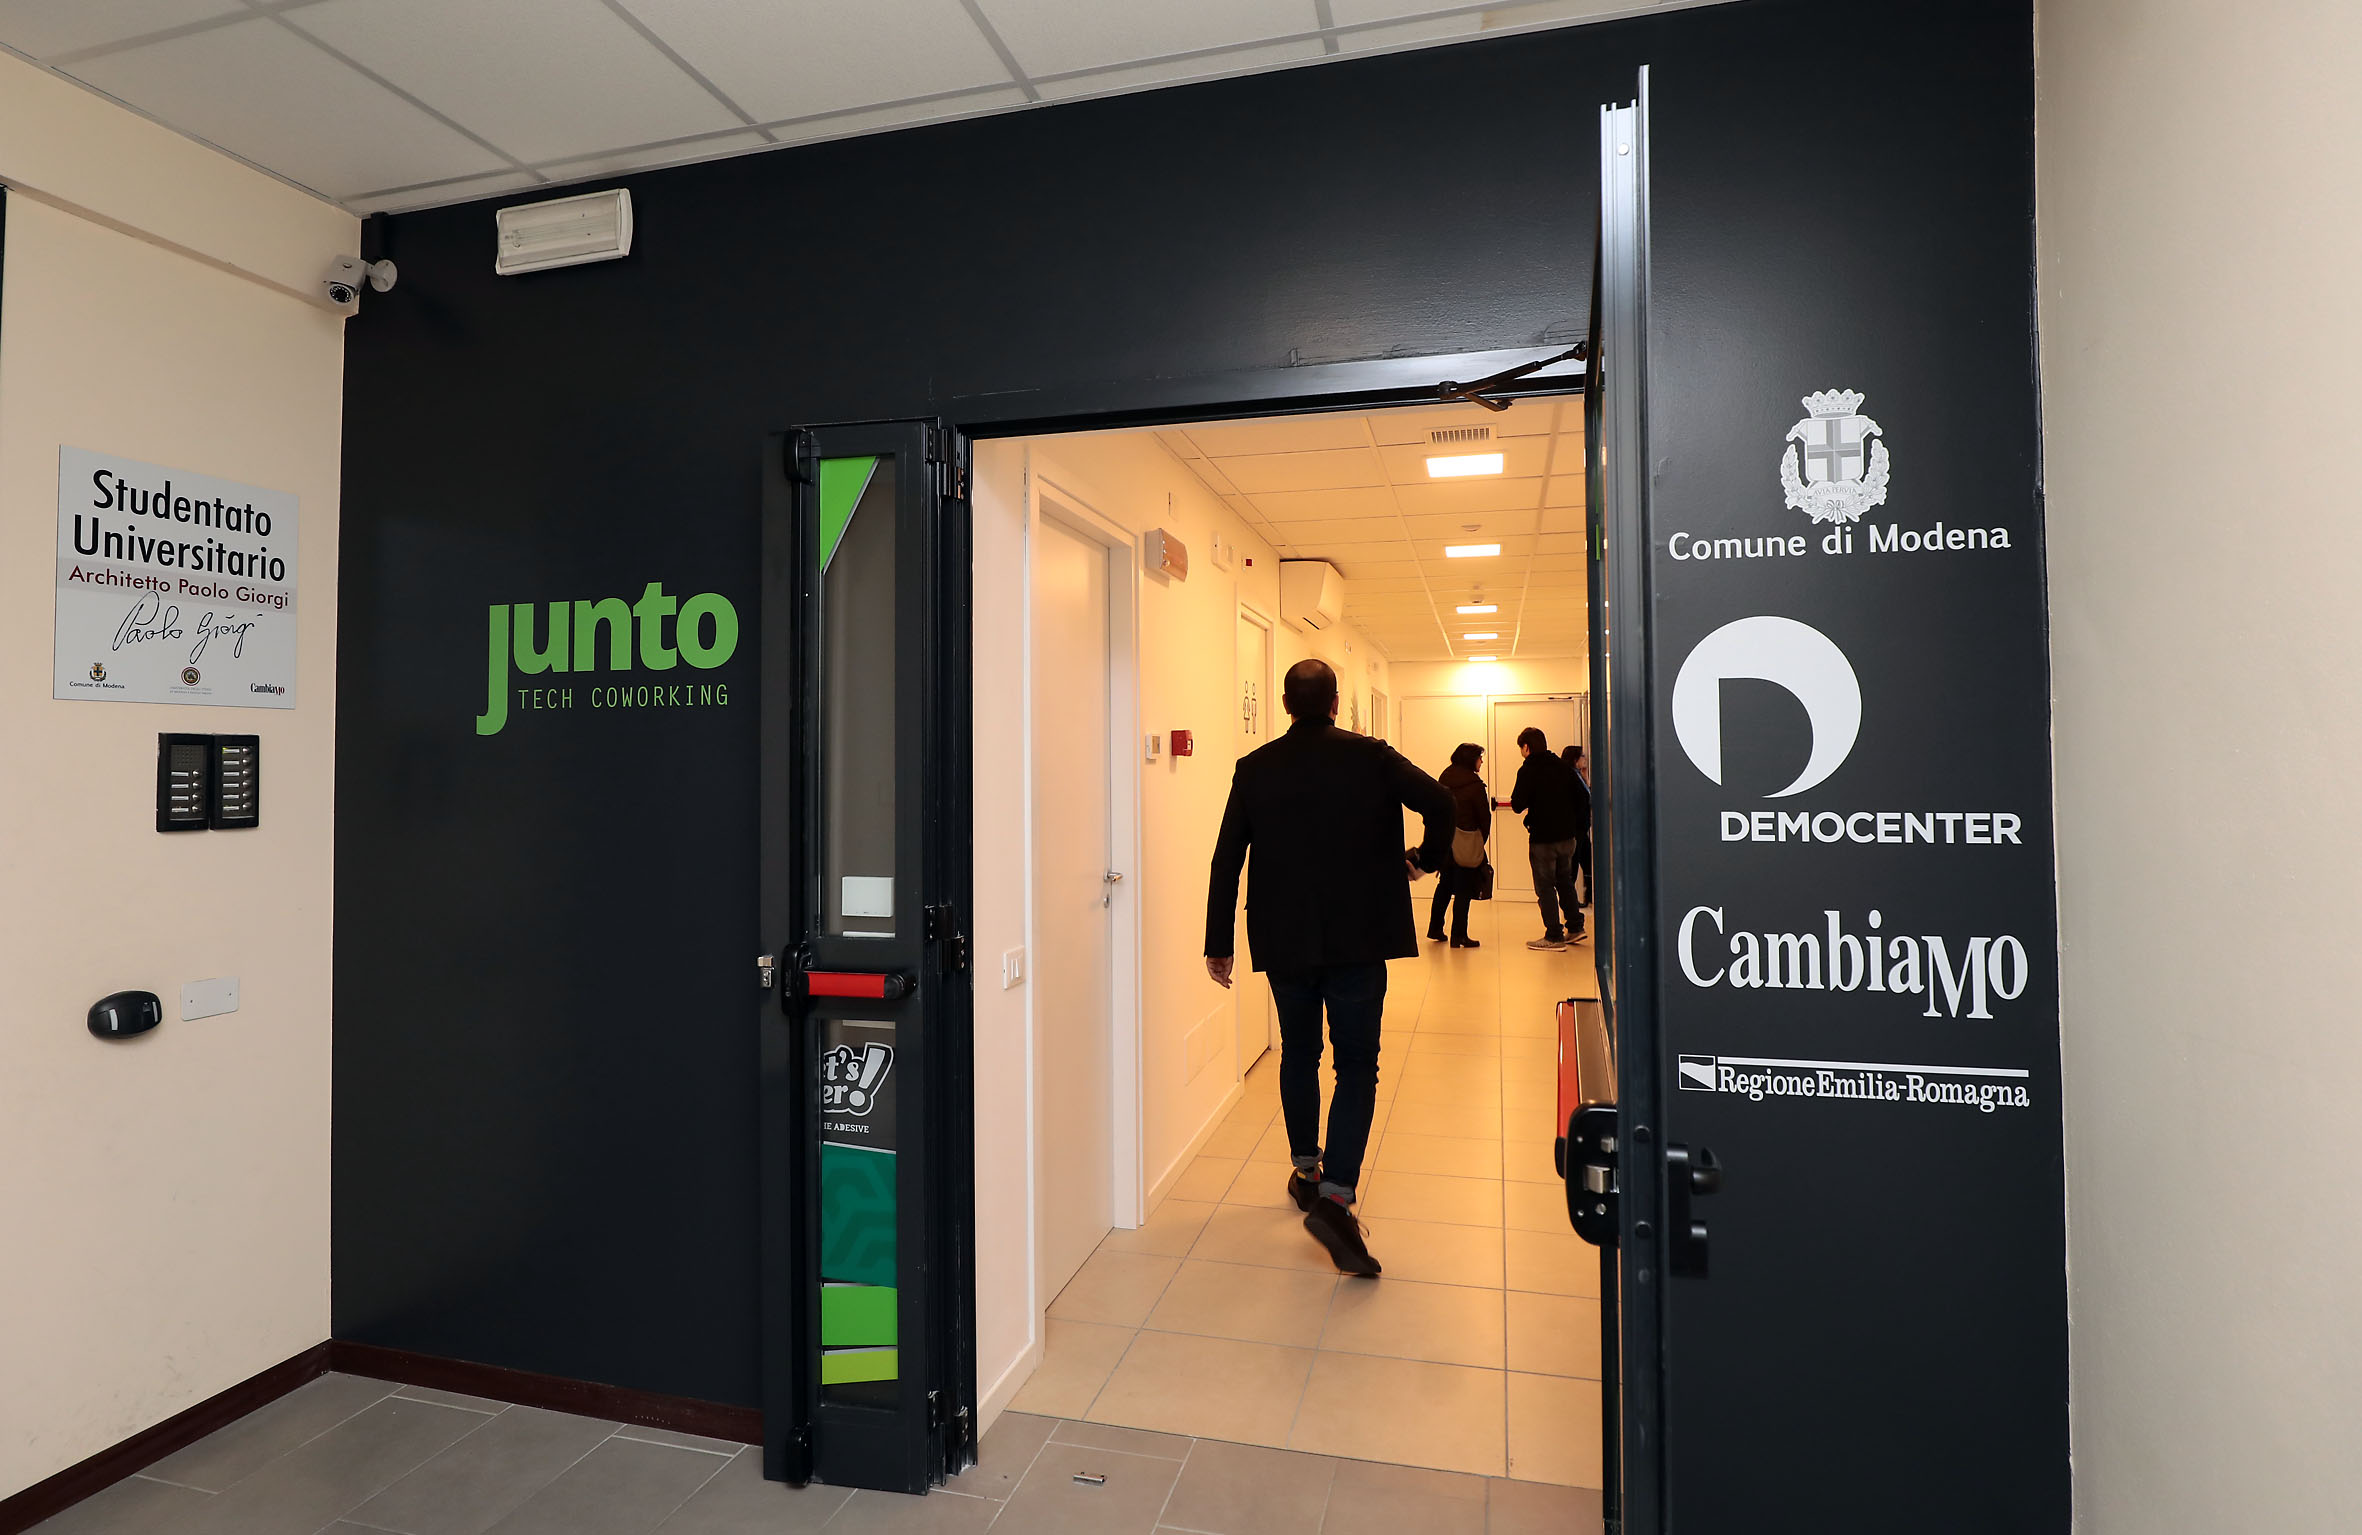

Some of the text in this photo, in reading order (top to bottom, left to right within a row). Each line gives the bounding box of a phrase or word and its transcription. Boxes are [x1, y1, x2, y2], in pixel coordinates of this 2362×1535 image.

[93, 469, 272, 537] Studentato
[73, 514, 286, 581] Universitario
[1668, 521, 2012, 561] Comune di Modena
[68, 565, 289, 610] Architetto Paolo Giorgi
[112, 590, 183, 652] Paolo
[476, 582, 739, 735] junto
[518, 683, 729, 710] TECH COWORKING
[1720, 811, 2023, 844] DEMOCENTER
[833, 1123, 870, 1134] ADESIVE
